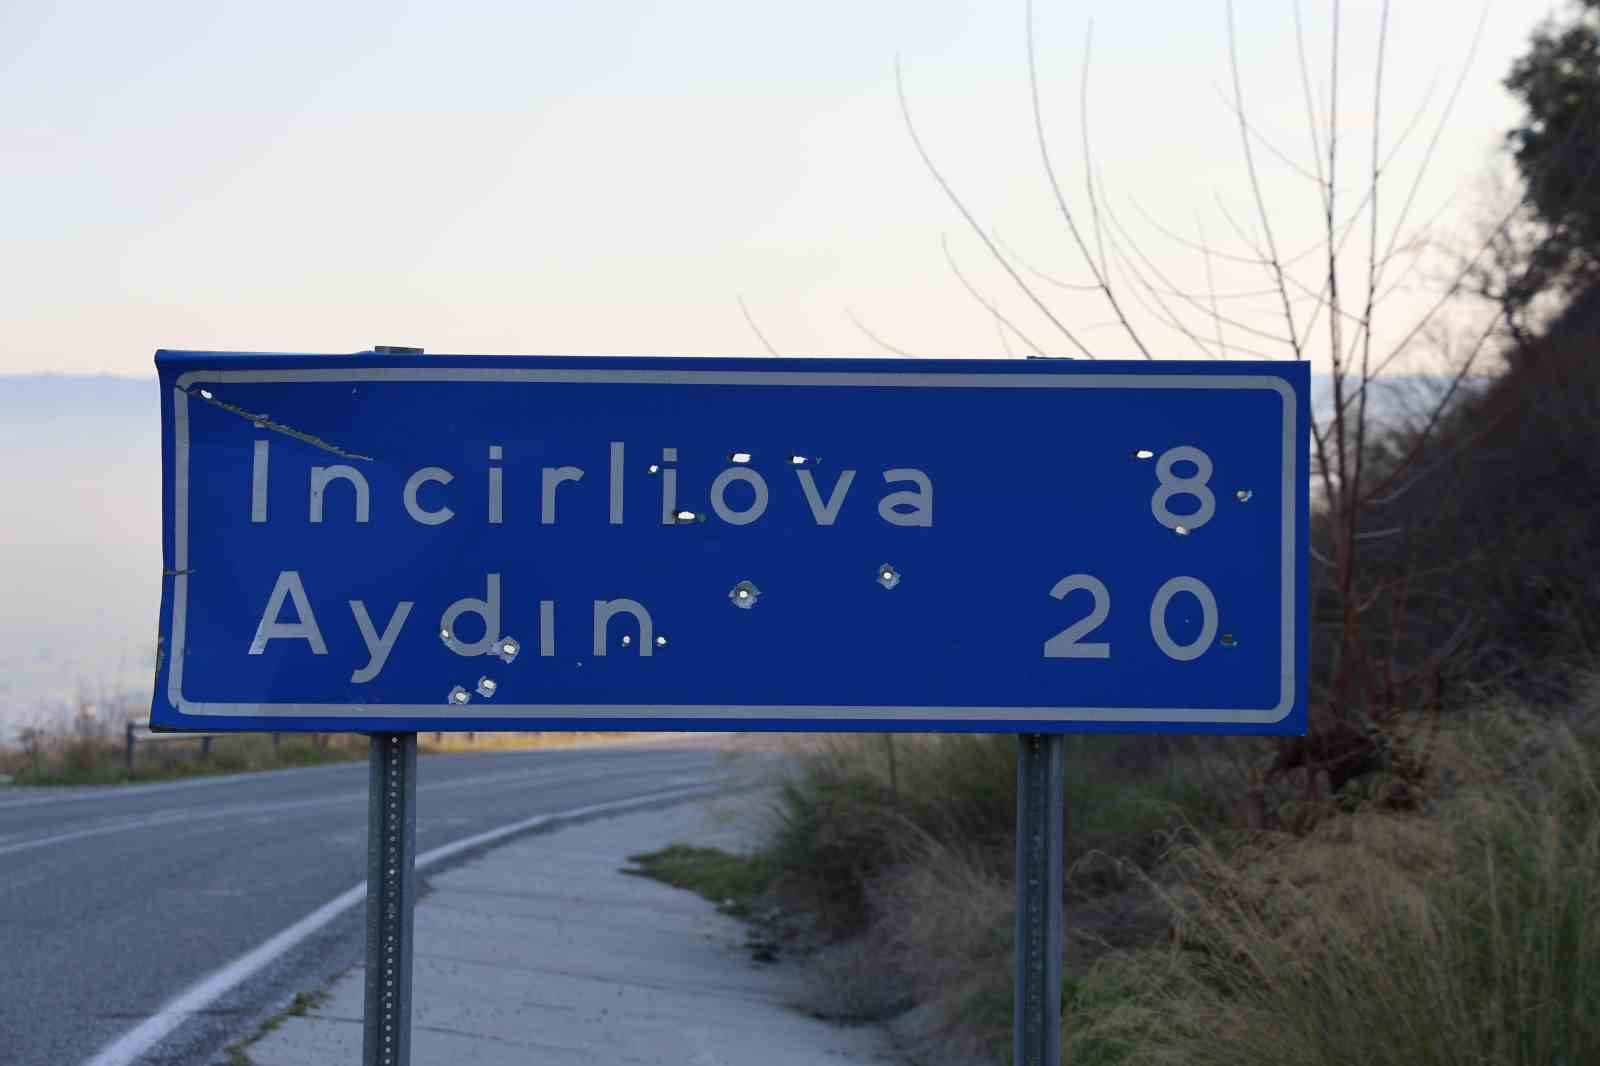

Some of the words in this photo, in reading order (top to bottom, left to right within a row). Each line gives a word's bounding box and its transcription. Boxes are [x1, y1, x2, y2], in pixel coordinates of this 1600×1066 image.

[1151, 446, 1216, 531] 8
[248, 571, 653, 683] Aydın
[1044, 574, 1218, 661] 20
